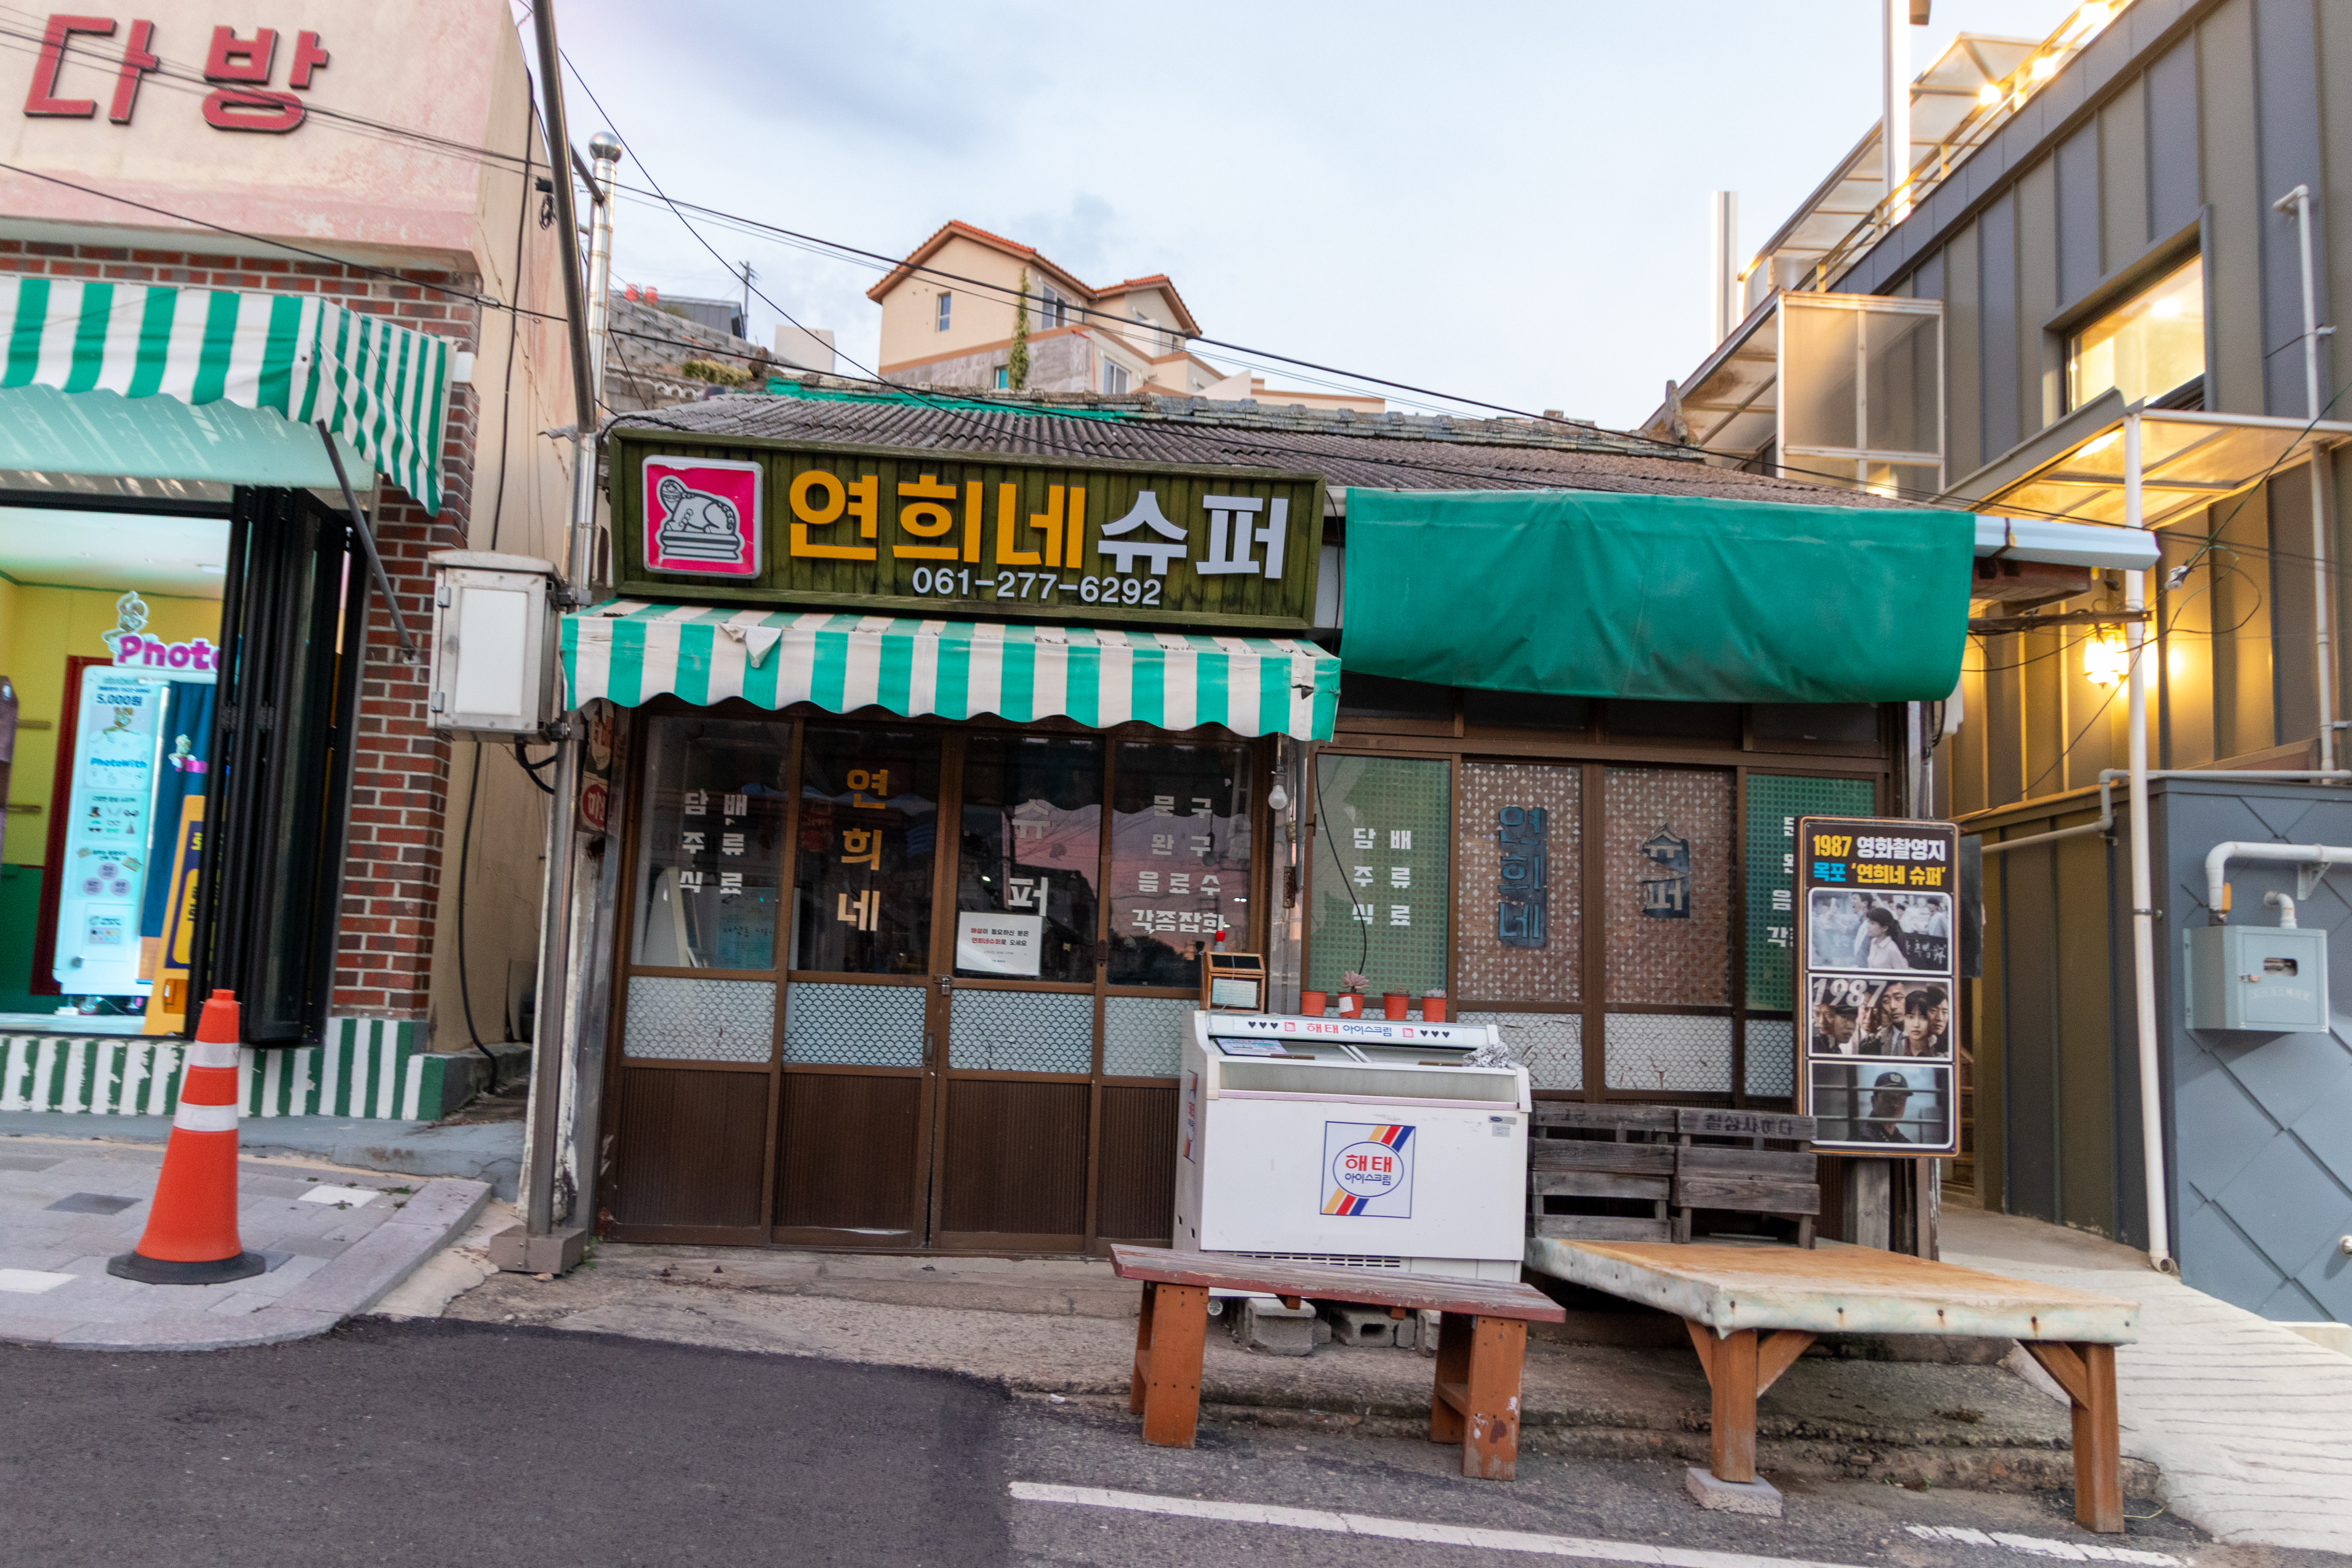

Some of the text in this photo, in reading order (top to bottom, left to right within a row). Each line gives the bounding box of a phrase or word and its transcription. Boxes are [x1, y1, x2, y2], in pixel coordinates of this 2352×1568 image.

[24, 14, 329, 133] 다방
[913, 568, 1161, 605] 061-277-6292
[1813, 835, 1945, 862] 1987 영화촬영지
[1814, 862, 1846, 882] 목포
[1132, 910, 1225, 935] 각종잡화
[1813, 978, 1887, 1007] 1987
[1343, 1025, 1392, 1037] 아이스크림
[1345, 1172, 1391, 1185] 아이스크림
